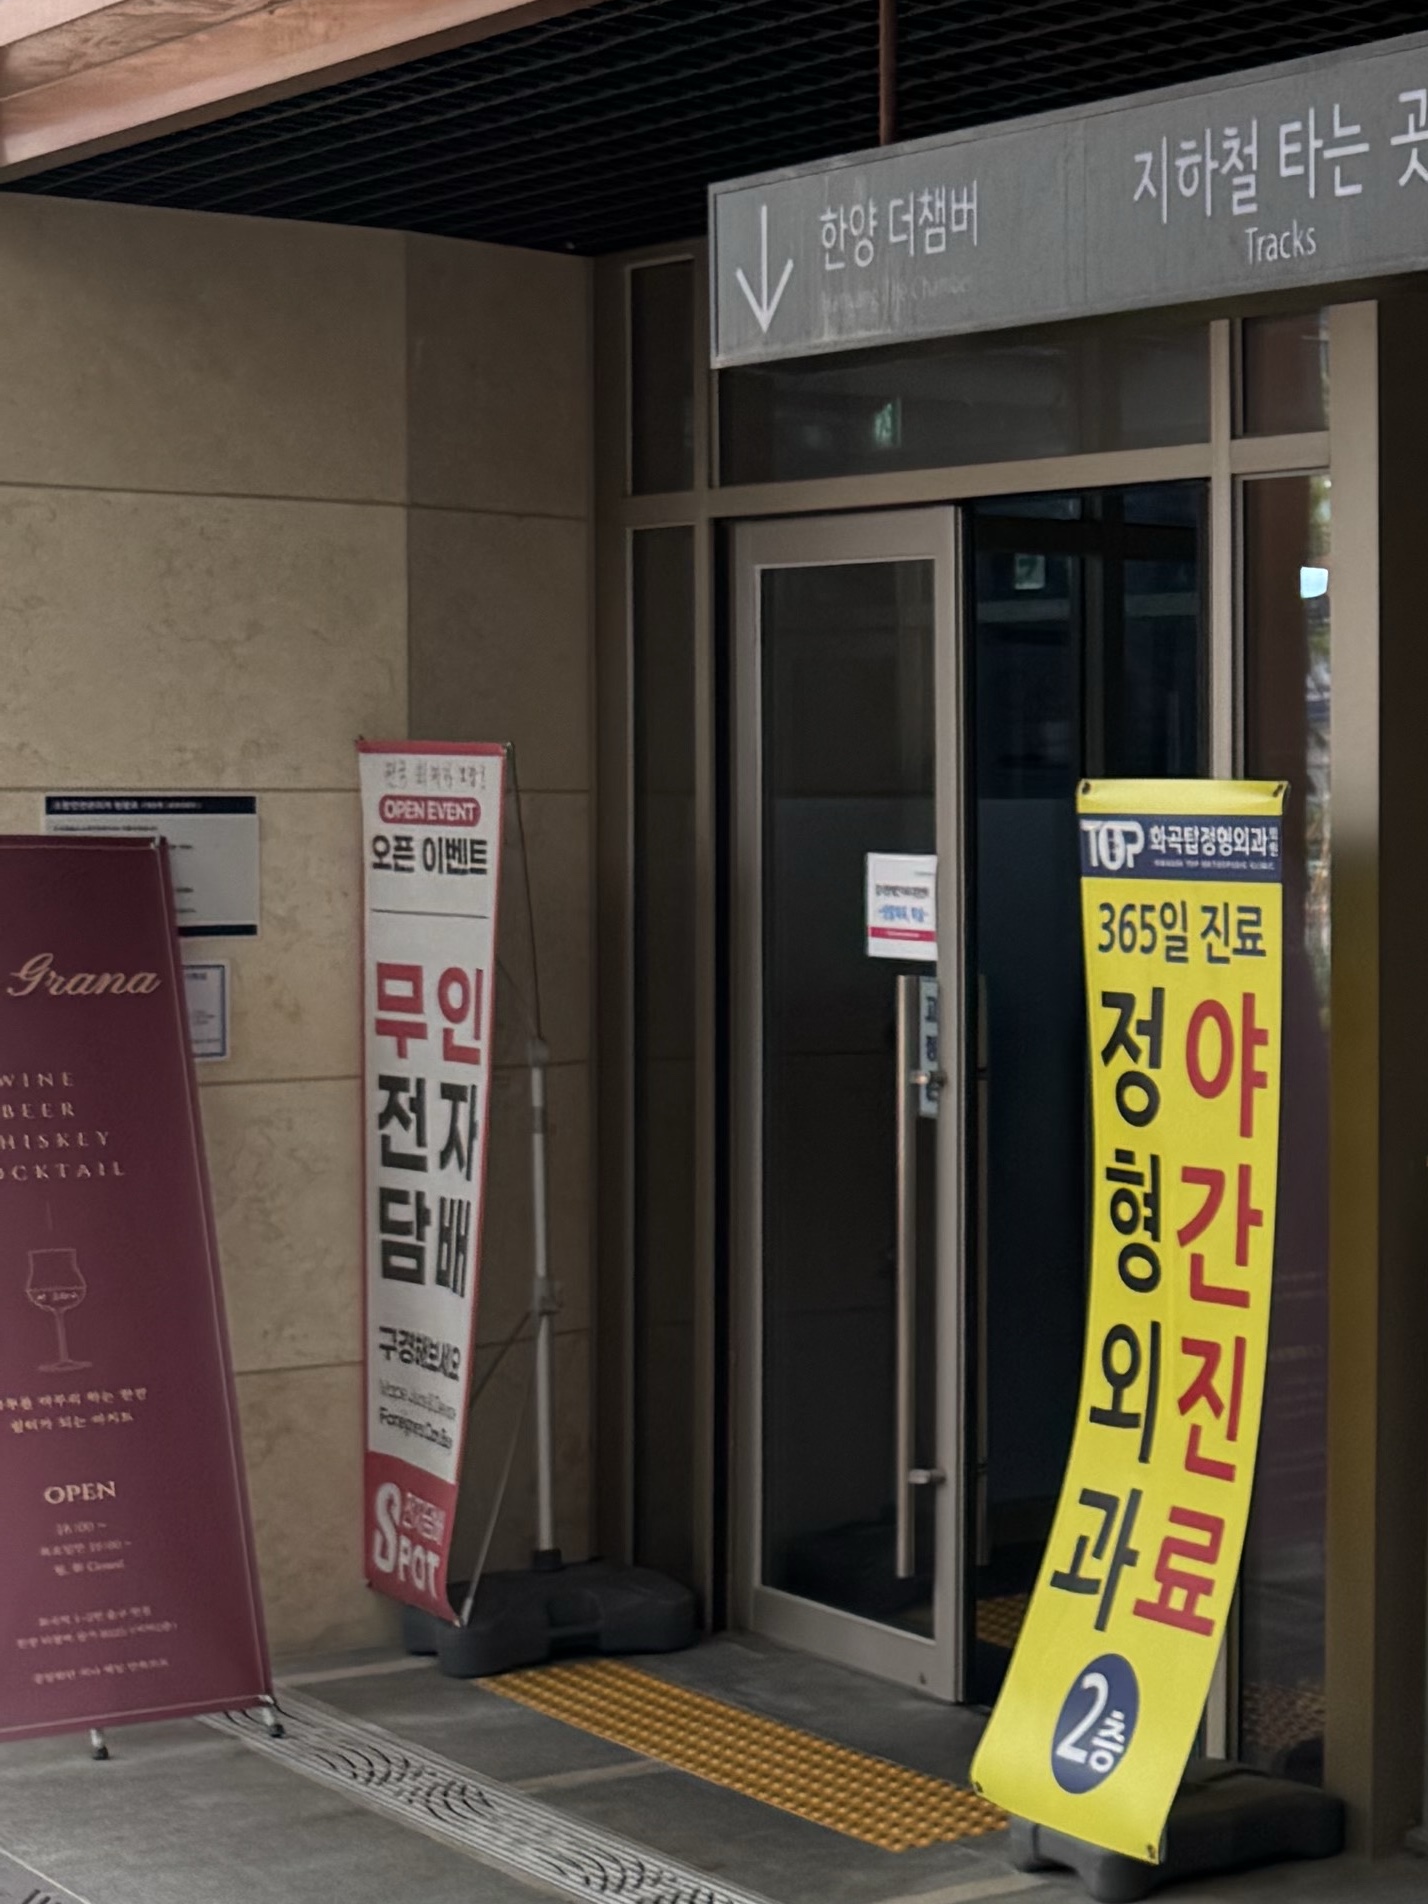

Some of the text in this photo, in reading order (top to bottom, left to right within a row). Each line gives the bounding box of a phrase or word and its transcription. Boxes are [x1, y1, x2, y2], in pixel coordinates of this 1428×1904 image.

[1130, 114, 1261, 225] 지하철
[1277, 100, 1372, 201] 타는
[819, 196, 878, 272] 한양
[1243, 221, 1319, 267] Tracks
[384, 799, 477, 822] OPEN EVENT
[1149, 824, 1268, 858] 화곡탑정형외과
[371, 834, 488, 876] 오픈 이벤트
[1080, 819, 1145, 871] TOP
[1097, 899, 1268, 966] 365일 진료
[7, 952, 163, 998] Grana
[374, 960, 483, 1066] 무인
[1, 1102, 76, 1120] BEER
[377, 1073, 480, 1183] 전자
[377, 1183, 471, 1299] 담배
[1048, 986, 1168, 1635] 정형외과
[1131, 991, 1270, 1638] 야간진료
[44, 1480, 117, 1505] OPEN
[1054, 1669, 1129, 1780] 2층
